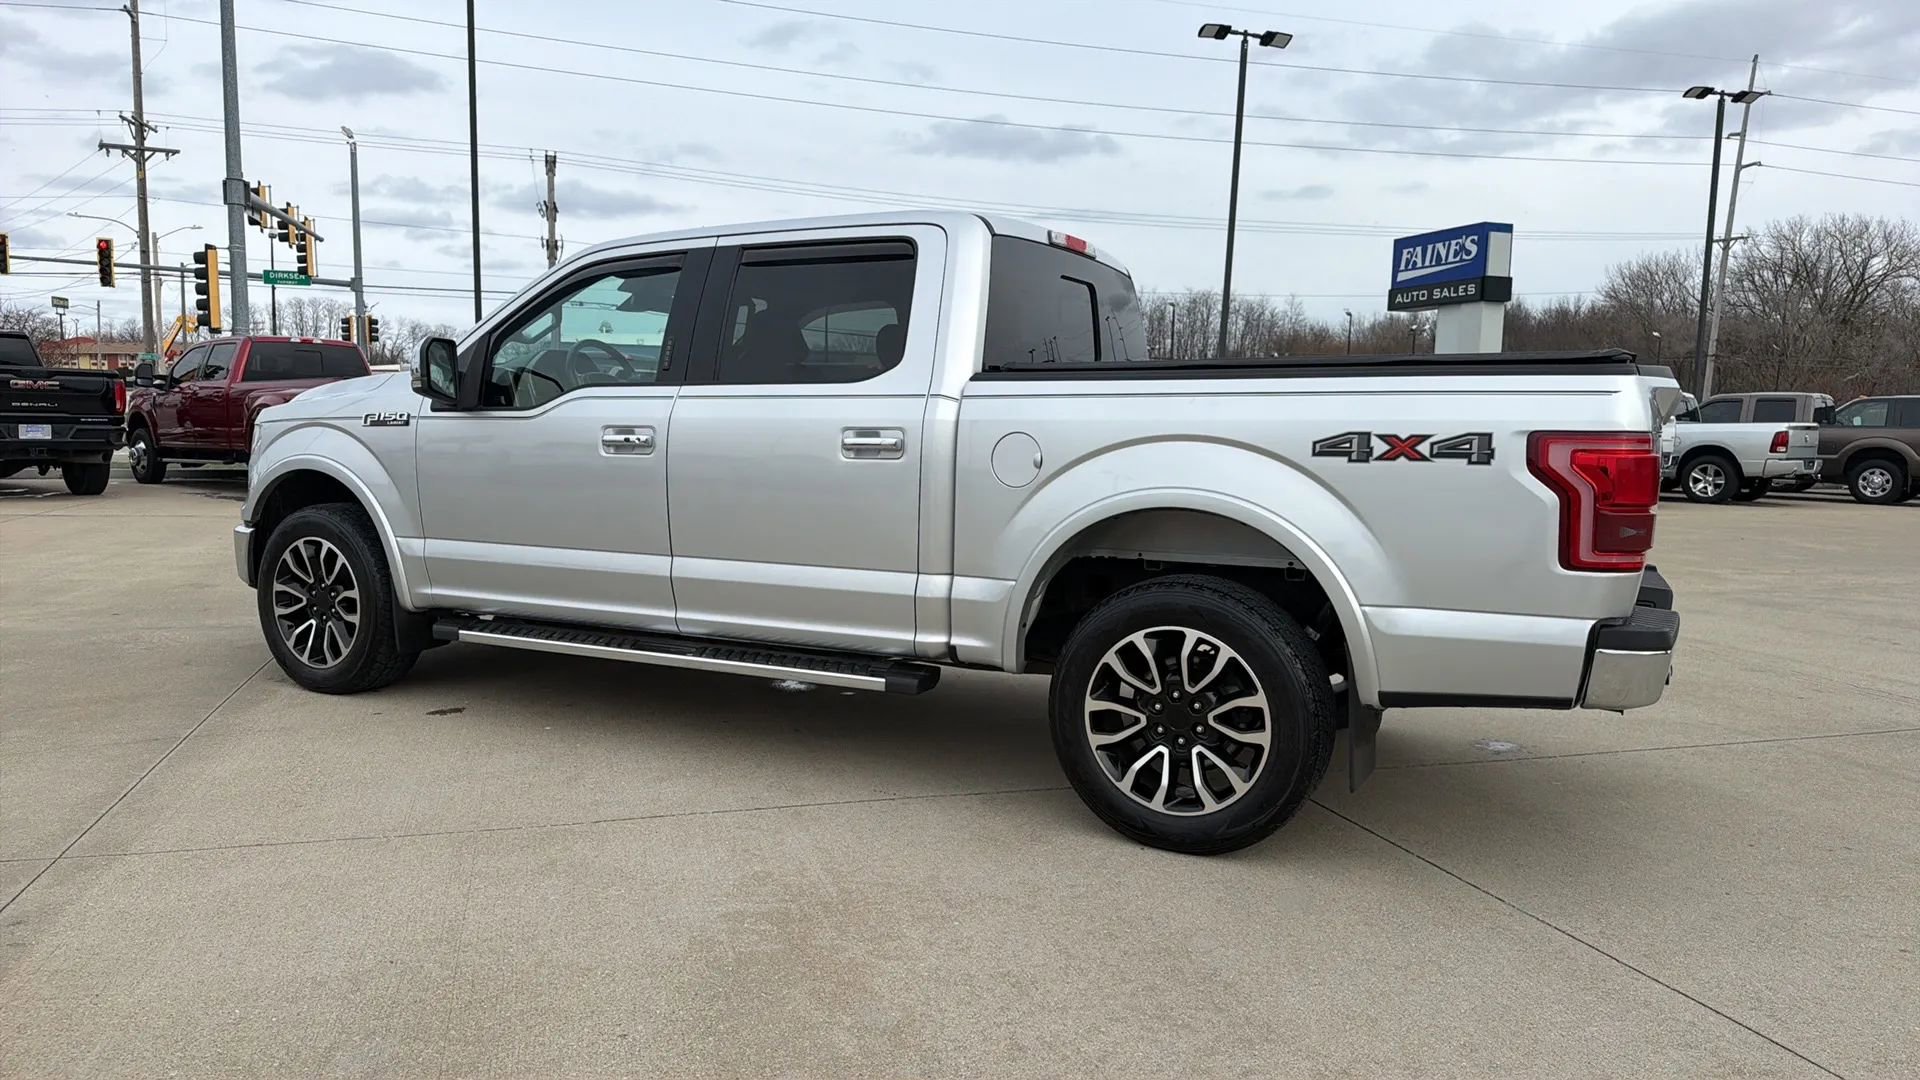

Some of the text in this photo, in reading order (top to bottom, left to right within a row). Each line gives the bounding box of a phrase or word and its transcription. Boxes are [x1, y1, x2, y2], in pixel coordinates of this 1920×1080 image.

[1399, 235, 1478, 271] FAINE'S
[1395, 284, 1476, 304] AUTO SALES
[10, 380, 60, 389] GMC
